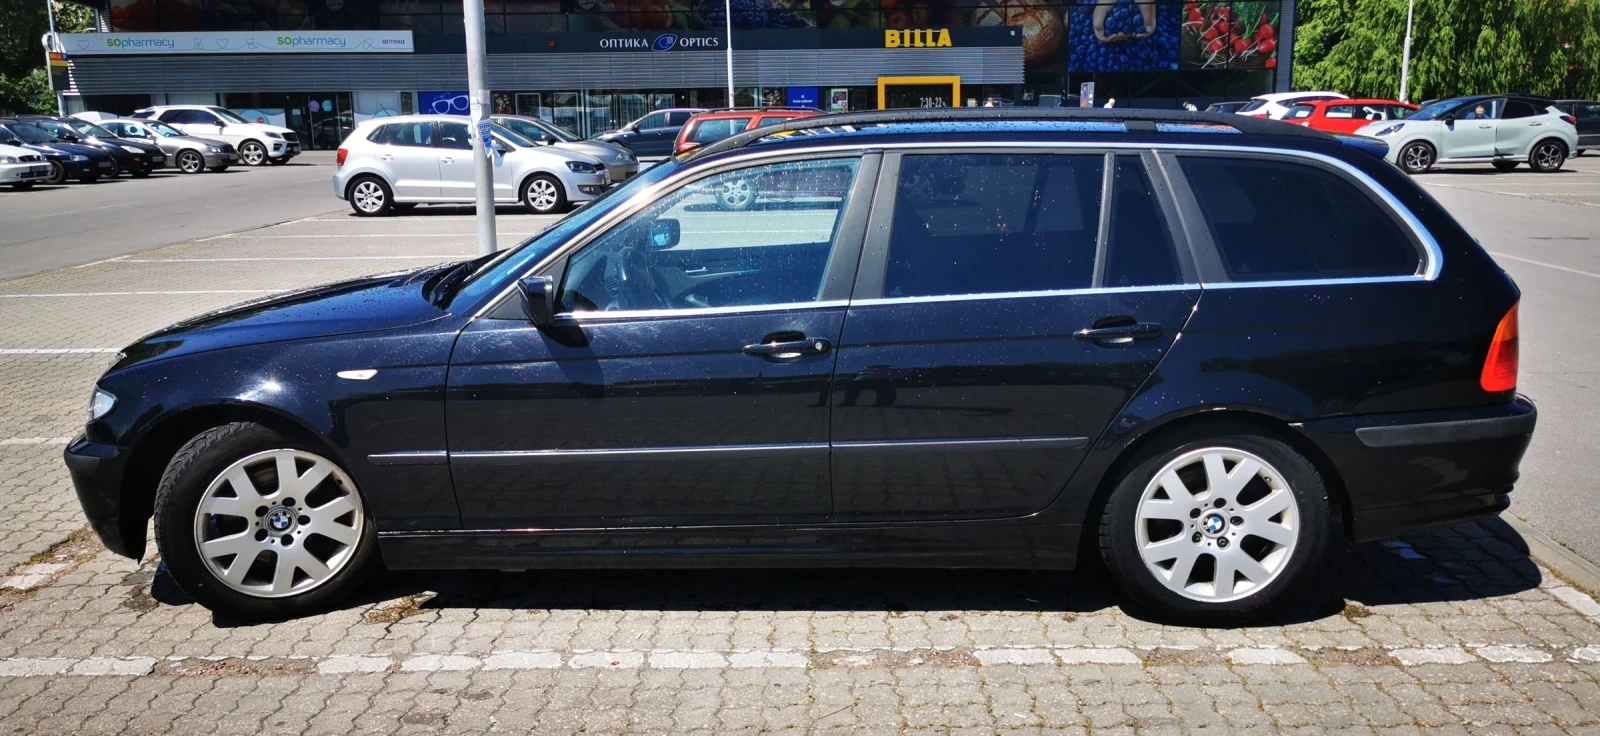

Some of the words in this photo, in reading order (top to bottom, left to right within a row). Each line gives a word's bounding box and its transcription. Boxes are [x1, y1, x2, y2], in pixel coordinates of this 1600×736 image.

[600, 38, 649, 48] ОПТИКА
[680, 37, 719, 47] OPTICS
[885, 28, 952, 48] BILLA
